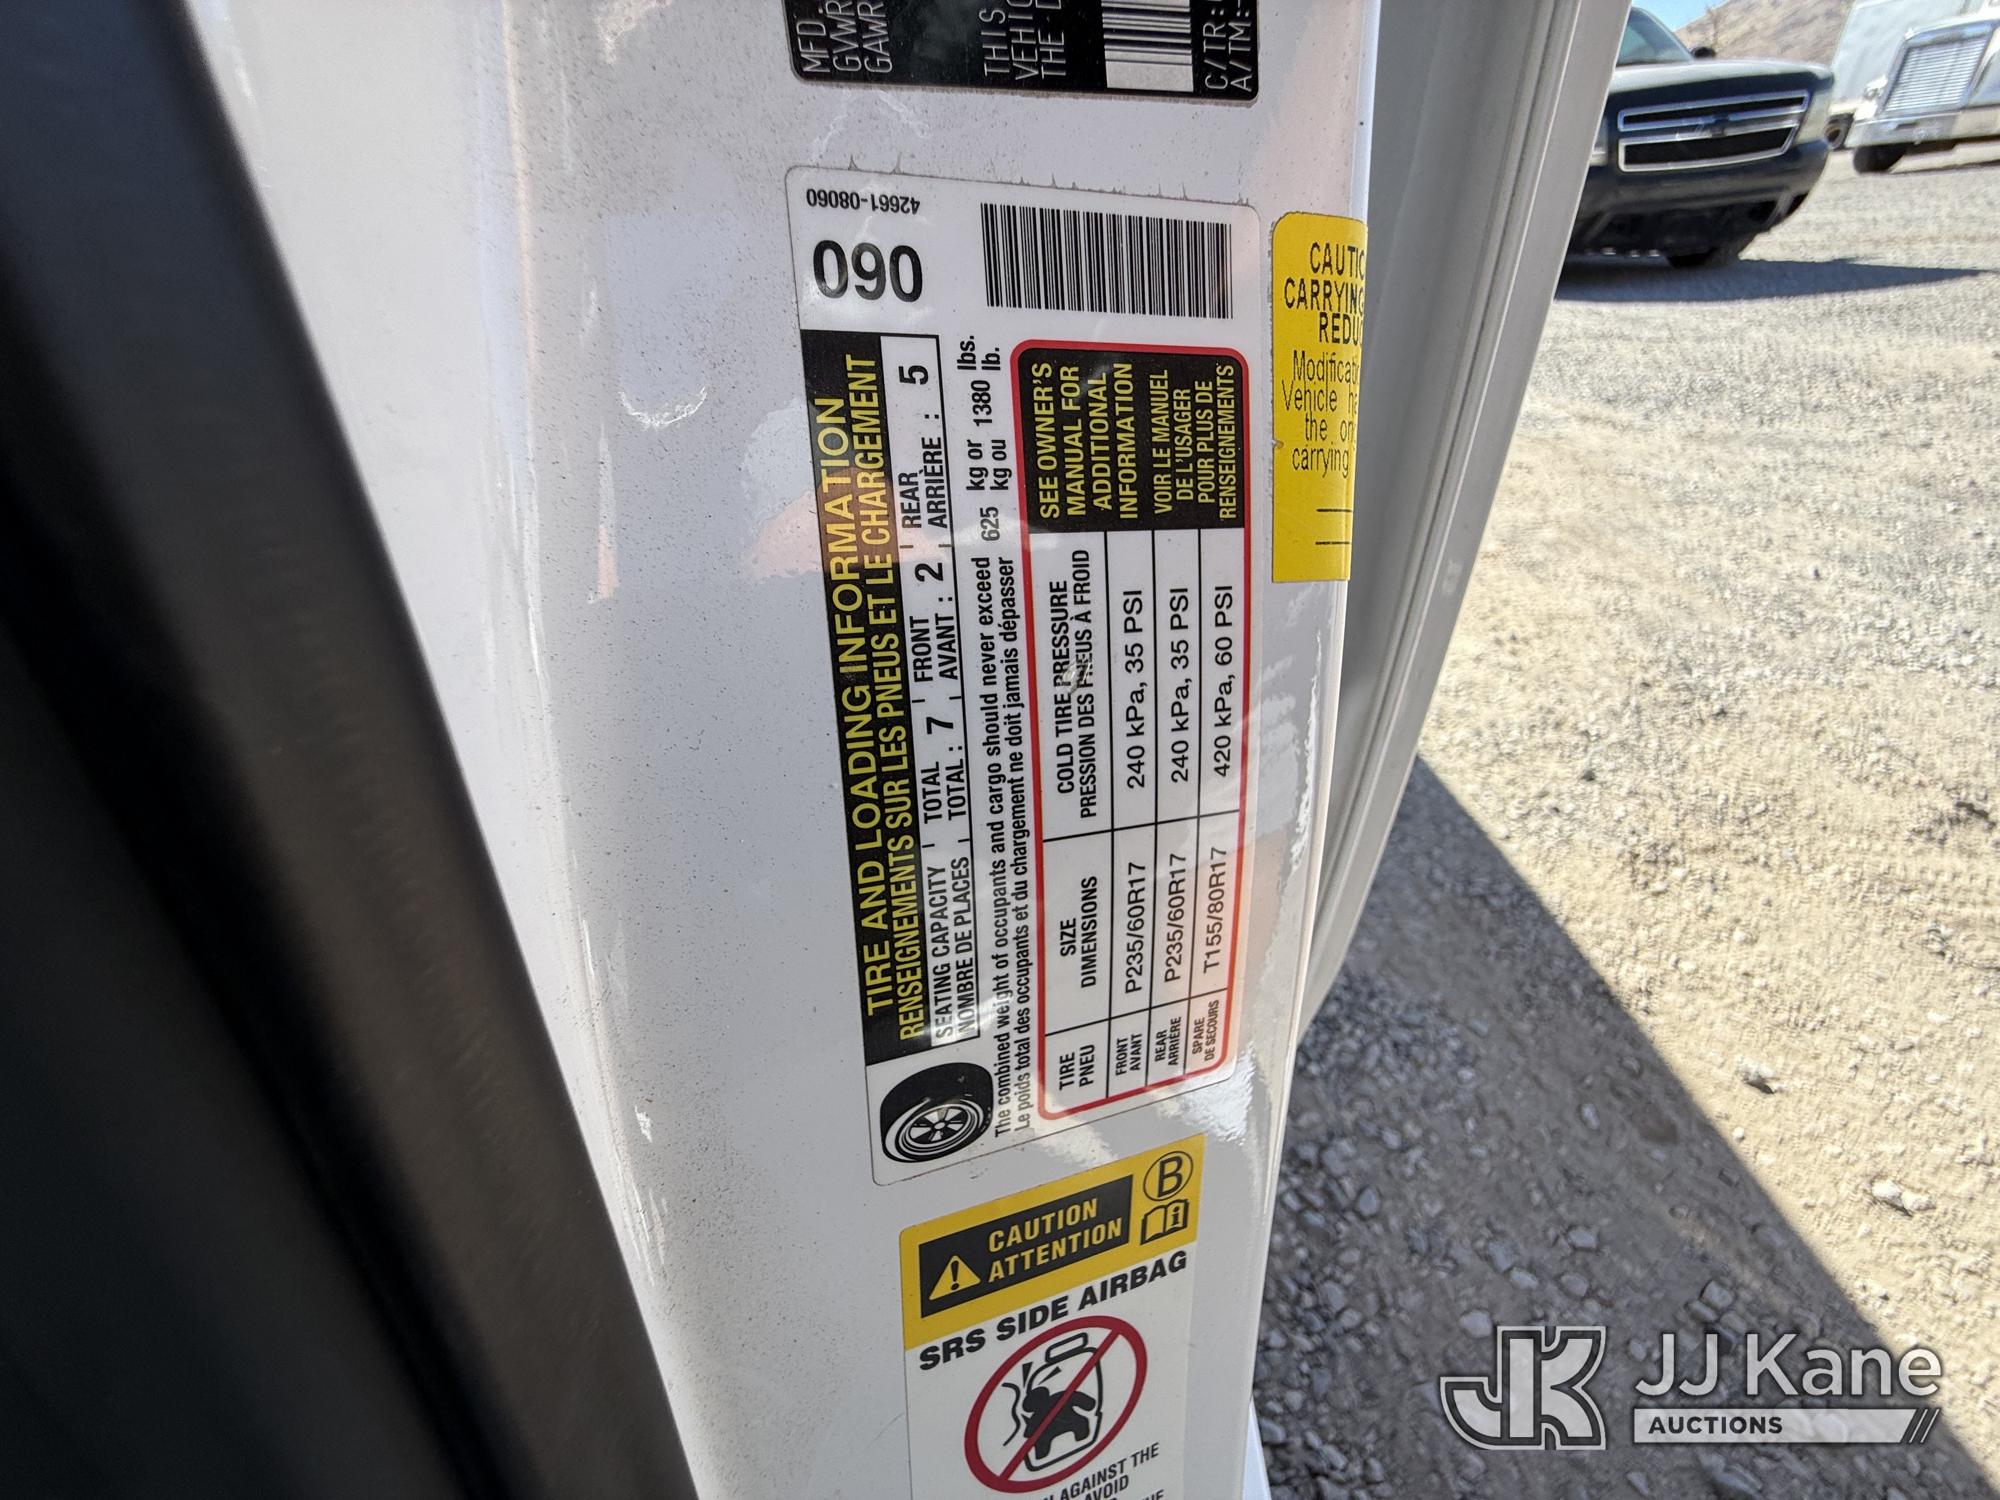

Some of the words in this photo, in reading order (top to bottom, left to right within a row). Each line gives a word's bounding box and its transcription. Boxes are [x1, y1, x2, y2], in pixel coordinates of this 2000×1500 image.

[826, 1, 861, 72] GVWR
[857, 2, 892, 73] GAWR
[979, 8, 1009, 76] THIS
[1037, 28, 1067, 79] THE
[806, 189, 920, 214] 42661-08060
[1319, 312, 1362, 345] REDU
[957, 335, 977, 370] lbs.
[981, 348, 1001, 370] lb.
[898, 365, 929, 385] 5
[1060, 367, 1081, 410] FOR
[1195, 381, 1212, 403] DE
[1282, 380, 1337, 412] Vehicle
[971, 380, 993, 426] 1380
[1032, 362, 1057, 470] OWNER'S
[1150, 370, 1170, 443] MANUEL
[967, 439, 982, 459] or
[1088, 372, 1112, 510] ADDITIONAL
[1114, 363, 1138, 518] INFORMATION
[1173, 389, 1193, 473] L'USAGER
[1196, 409, 1214, 452] PLUS
[1216, 365, 1236, 518] RENSEIGNEMENTS
[1305, 412, 1327, 442] the
[845, 354, 891, 545] CHARGEMENT
[991, 439, 1007, 460] ou
[1063, 419, 1086, 516] MANUAL
[1153, 447, 1171, 468] LE
[1293, 443, 1349, 478] carrying
[898, 472, 922, 528] REAR
[966, 467, 989, 490] kg
[990, 468, 1012, 490] kg
[1039, 477, 1059, 518] SEE
[1153, 474, 1172, 514] VOIR
[1176, 478, 1193, 500] DE
[1197, 459, 1215, 503] POUR
[814, 398, 869, 674] INFORMATION
[980, 506, 1000, 541] 625
[864, 554, 894, 584] LE
[915, 563, 943, 582] 2
[971, 557, 993, 625] exceed
[1072, 550, 1091, 605] FROID
[868, 594, 897, 625] ET
[998, 557, 1020, 642] dépasser
[1123, 590, 1143, 633] PSI
[1170, 588, 1188, 630] PSI
[1215, 586, 1233, 627] PSI
[910, 616, 933, 682] FRONT
[1050, 580, 1071, 687] PRESSURE
[1171, 640, 1188, 669] 35
[1215, 637, 1233, 665] 60
[870, 633, 904, 718] PNEUS
[980, 632, 997, 686] never
[1001, 647, 1025, 709] jamais
[1125, 643, 1143, 673] 35
[1054, 694, 1072, 737] TIRE
[1077, 693, 1094, 727] DES
[1126, 682, 1147, 737] kPa,
[1171, 678, 1192, 732] kPa,
[1214, 675, 1235, 727] kPa,
[926, 717, 954, 734] 7
[980, 693, 1000, 756] should
[1004, 713, 1022, 746] doit
[842, 685, 882, 850] LOADING
[878, 725, 909, 772] LES
[1009, 751, 1024, 773] ne
[1056, 743, 1075, 794] COLD
[1127, 745, 1145, 789] 240
[1171, 740, 1188, 783] 240
[1214, 735, 1231, 778] 420
[921, 762, 942, 824] TOTAL
[987, 763, 1006, 815] cargo
[1078, 733, 1097, 819] PRESSION
[883, 779, 912, 828] SUR
[987, 821, 1006, 854] and
[1007, 777, 1030, 879] chargement
[857, 861, 888, 930] AND
[951, 856, 972, 927] PLACES
[989, 858, 1012, 947] occupants
[1012, 880, 1028, 899] du
[1204, 847, 1227, 973] T155/80R17
[927, 867, 950, 957] CAPACITY
[1012, 905, 1029, 920] et
[1081, 876, 1097, 988] DIMENSIONS
[1125, 862, 1145, 994] P235/60R17
[1164, 853, 1186, 983] P235/60R17
[887, 834, 925, 1041] RENSEIGNEMENTS
[954, 930, 972, 954] DE
[1060, 918, 1076, 956] SIZE
[864, 941, 893, 1016] TIRE
[992, 955, 1009, 969] of
[1012, 925, 1033, 1003] occupants
[931, 963, 953, 1039] SEATING
[956, 957, 975, 1033] NOMBRE
[993, 974, 1013, 1029] weight
[1014, 1007, 1030, 1035] des
[1192, 1017, 1205, 1054] SPARE
[1205, 1000, 1219, 1046] SECOURS
[1014, 1037, 1030, 1071] total
[1079, 1045, 1095, 1087] PNEU
[1115, 1038, 1128, 1076] FRONT
[1130, 1034, 1142, 1071] AVANT
[1155, 1030, 1167, 1062] REAR
[1204, 1046, 1215, 1061] DE
[994, 1032, 1011, 1105] combined
[1060, 1052, 1075, 1091] TIRE
[1014, 1072, 1033, 1110] poids
[995, 1105, 1011, 1137] The
[1015, 1113, 1030, 1131] Le
[1157, 1156, 1183, 1198] B
[987, 1199, 1097, 1253] CAUTION
[988, 1217, 1122, 1283] ATTENTION
[920, 1329, 986, 1371] SRS
[996, 1296, 1069, 1341] SIDE
[1079, 1251, 1187, 1311] AIRBAG
[1060, 1458, 1127, 1500] AGAINST
[1131, 1443, 1159, 1467] THE
